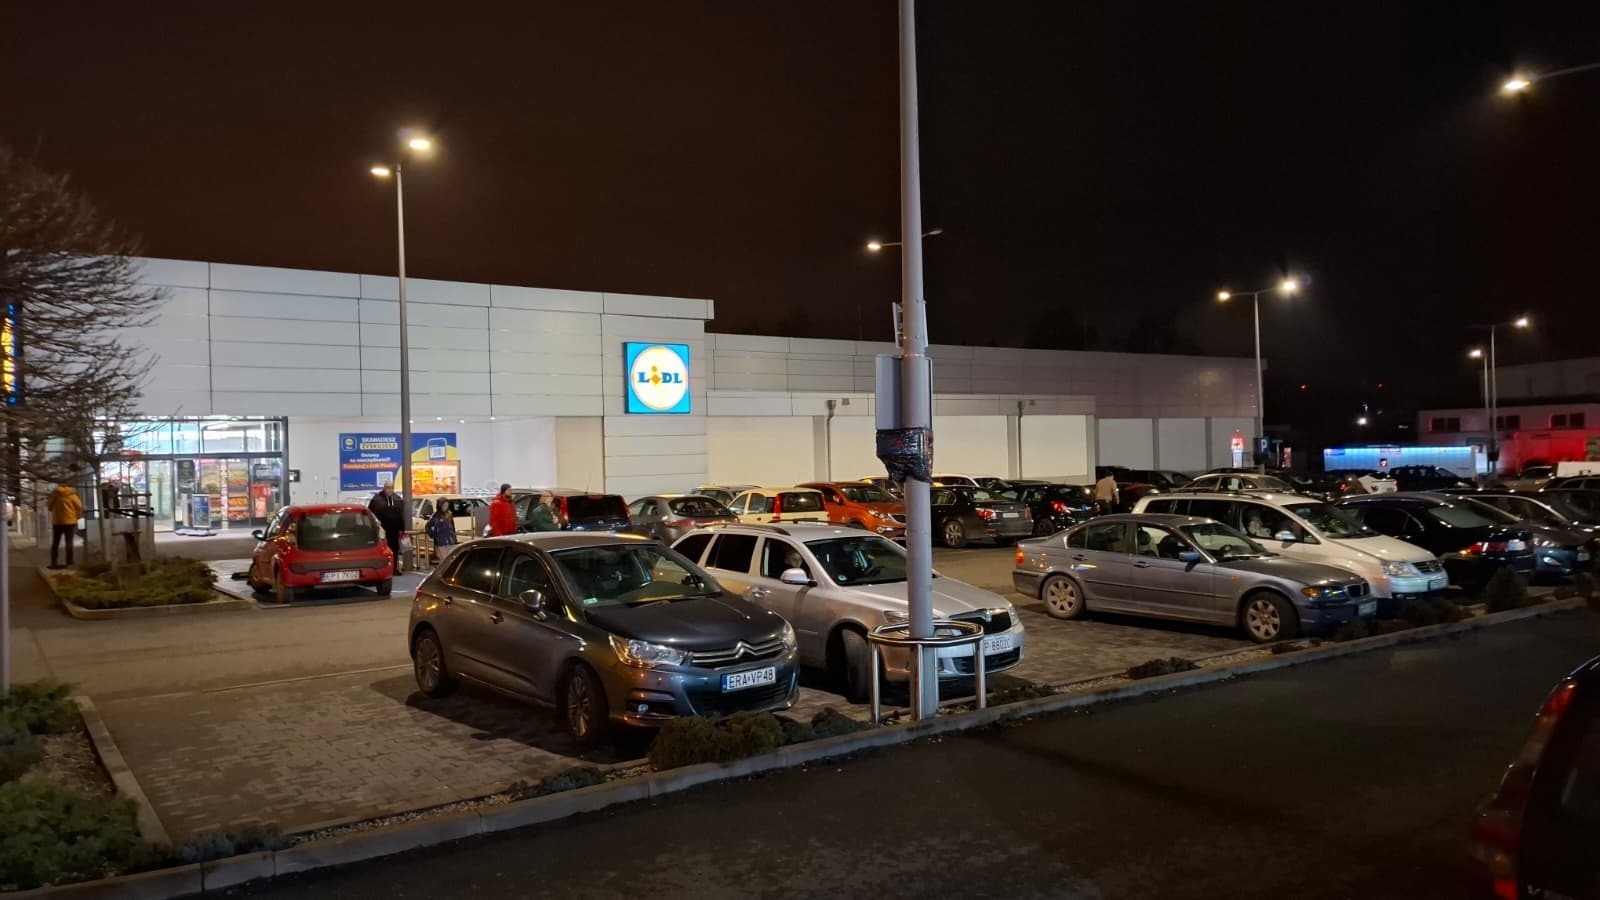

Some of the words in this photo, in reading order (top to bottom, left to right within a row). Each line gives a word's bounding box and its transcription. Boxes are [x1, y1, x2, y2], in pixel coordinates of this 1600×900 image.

[1261, 439, 1267, 453] P
[729, 674, 747, 688] ERA
[750, 669, 774, 684] VP48
